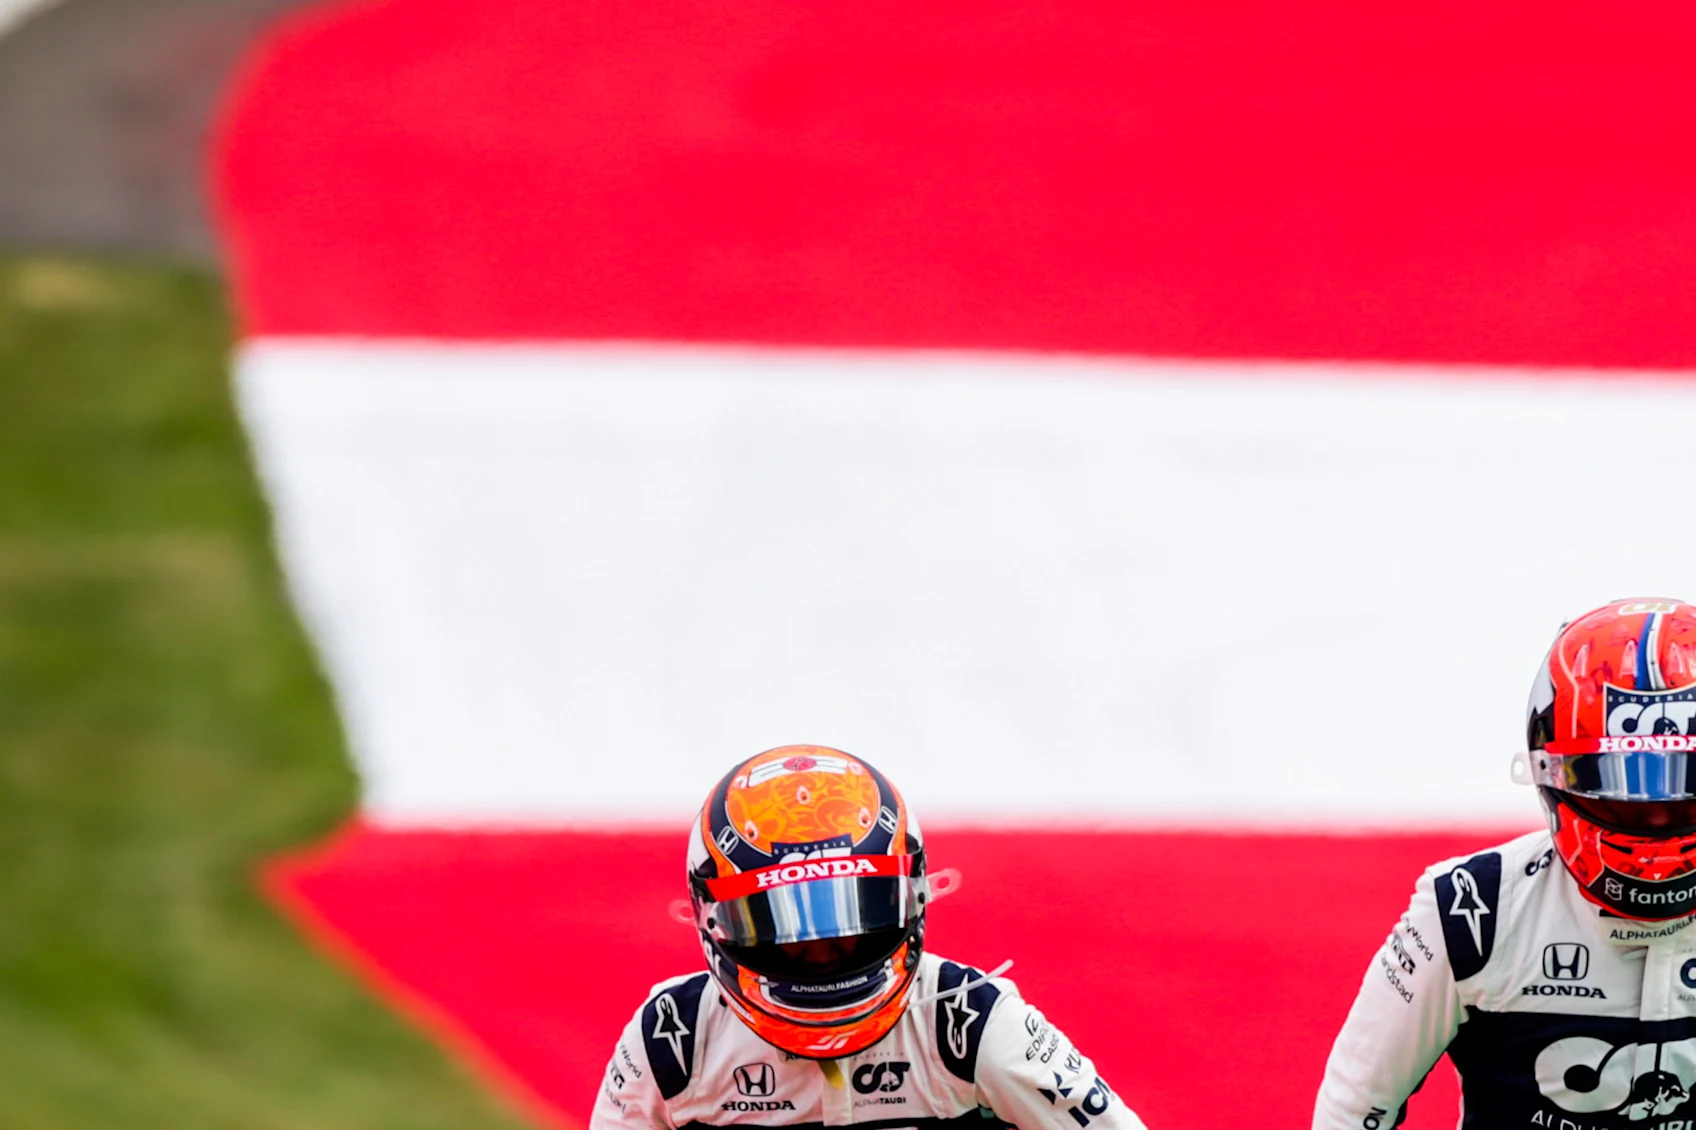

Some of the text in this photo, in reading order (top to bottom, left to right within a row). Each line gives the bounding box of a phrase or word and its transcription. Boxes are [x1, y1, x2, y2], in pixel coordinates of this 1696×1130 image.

[756, 858, 878, 888] HONDA
[1521, 984, 1607, 1000] HONDA
[720, 1099, 796, 1112] HONDA
